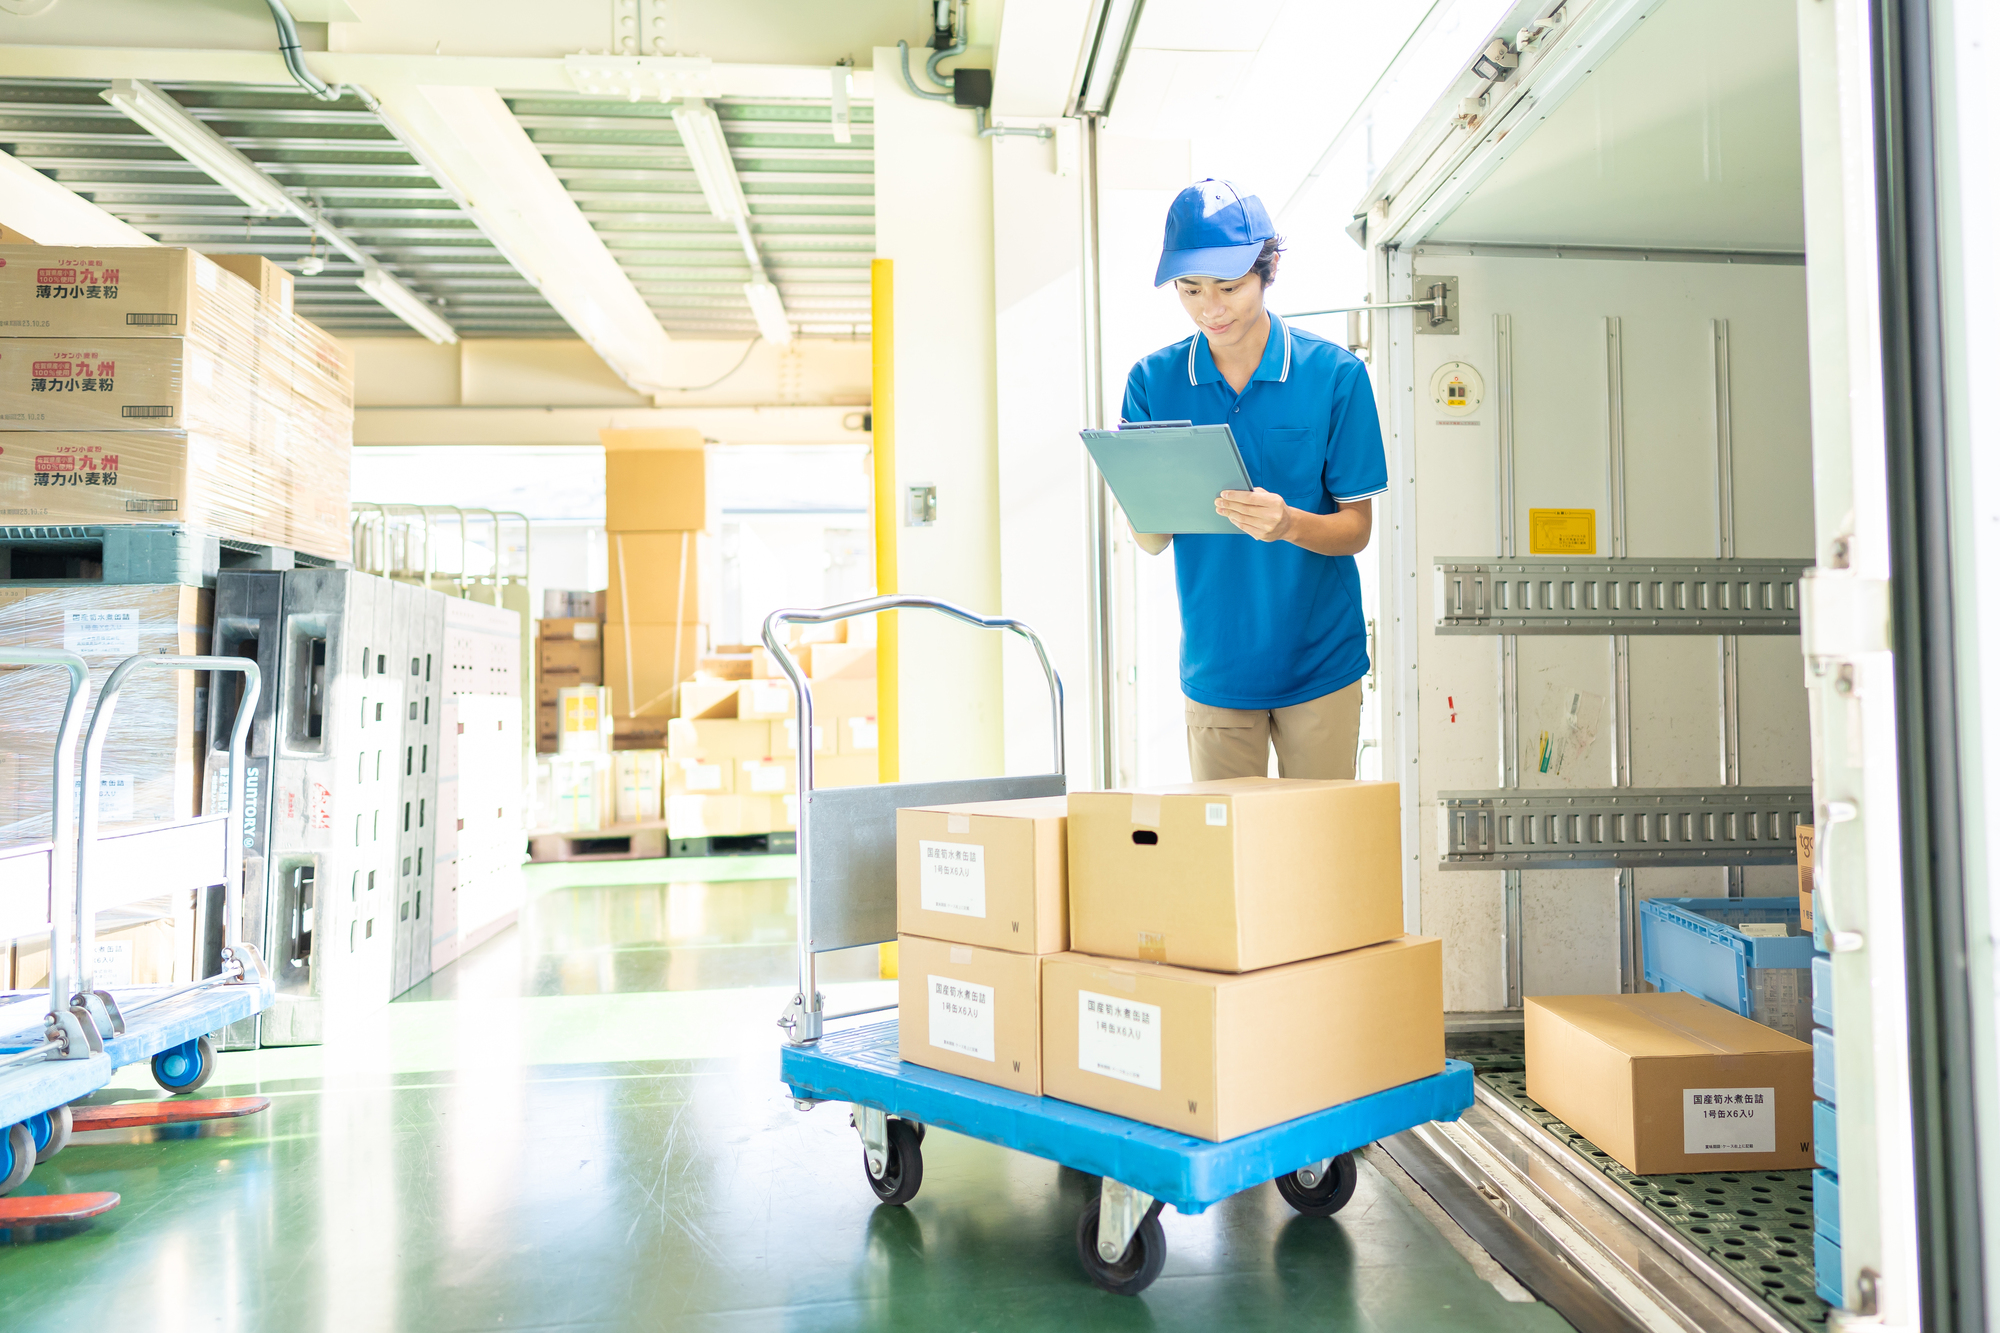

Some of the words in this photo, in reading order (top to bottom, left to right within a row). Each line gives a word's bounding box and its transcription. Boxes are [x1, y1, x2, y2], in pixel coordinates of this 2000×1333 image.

[58, 259, 103, 267] リケン小麦粉
[39, 276, 76, 284] 100%使用
[80, 268, 120, 285] 九州
[36, 285, 118, 299] 薄力小麦粉
[53, 352, 99, 360] リケン小麦粉
[34, 369, 70, 377] 100%使用
[75, 361, 115, 378] 九州
[31, 378, 114, 392] 薄力小麦粉
[78, 454, 119, 471] 九州
[34, 472, 118, 486] 薄力小麦粉
[243, 767, 260, 837] SUNTORY
[927, 847, 977, 862] 国産筍水煮缶詰
[934, 865, 970, 877] 1号缶X6入り
[1011, 921, 1019, 933] W
[935, 983, 986, 1004] 国産筍水煮缶詰
[942, 1002, 979, 1018] 1号缶X6入り
[1087, 999, 1150, 1025] 国産筍水煮缶詰
[1012, 1060, 1021, 1073] W
[1693, 1094, 1764, 1104] 国産筍水煮缶詰
[1187, 1099, 1198, 1115] W
[1703, 1109, 1754, 1119] 1号缶X6入り
[1800, 1142, 1810, 1152] W
